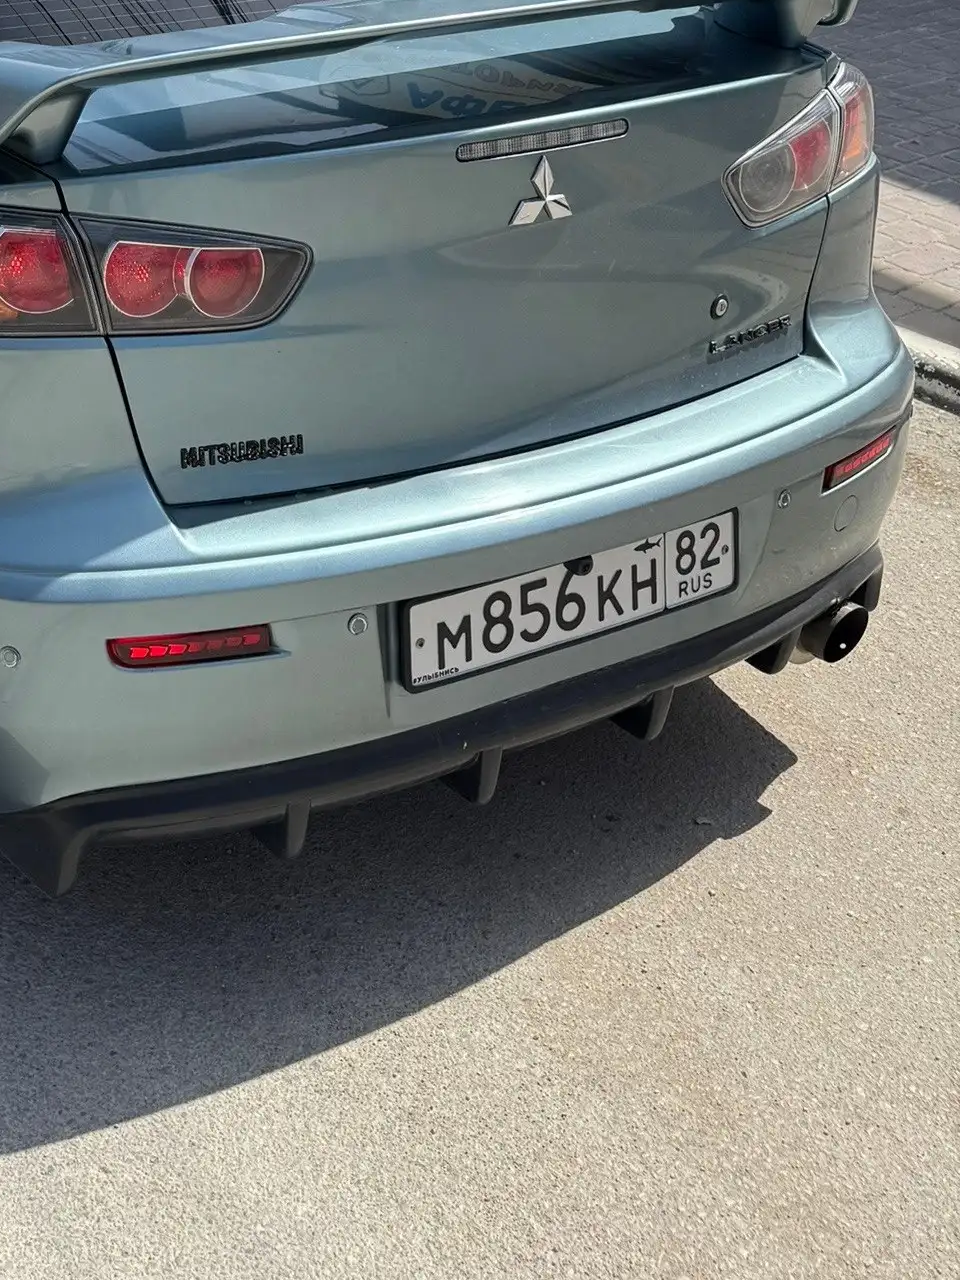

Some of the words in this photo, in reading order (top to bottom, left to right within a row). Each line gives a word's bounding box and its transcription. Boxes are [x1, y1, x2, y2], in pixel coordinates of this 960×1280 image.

[180, 433, 304, 469] MITSUBISHI
[676, 522, 721, 575] 82
[679, 572, 713, 599] RUS
